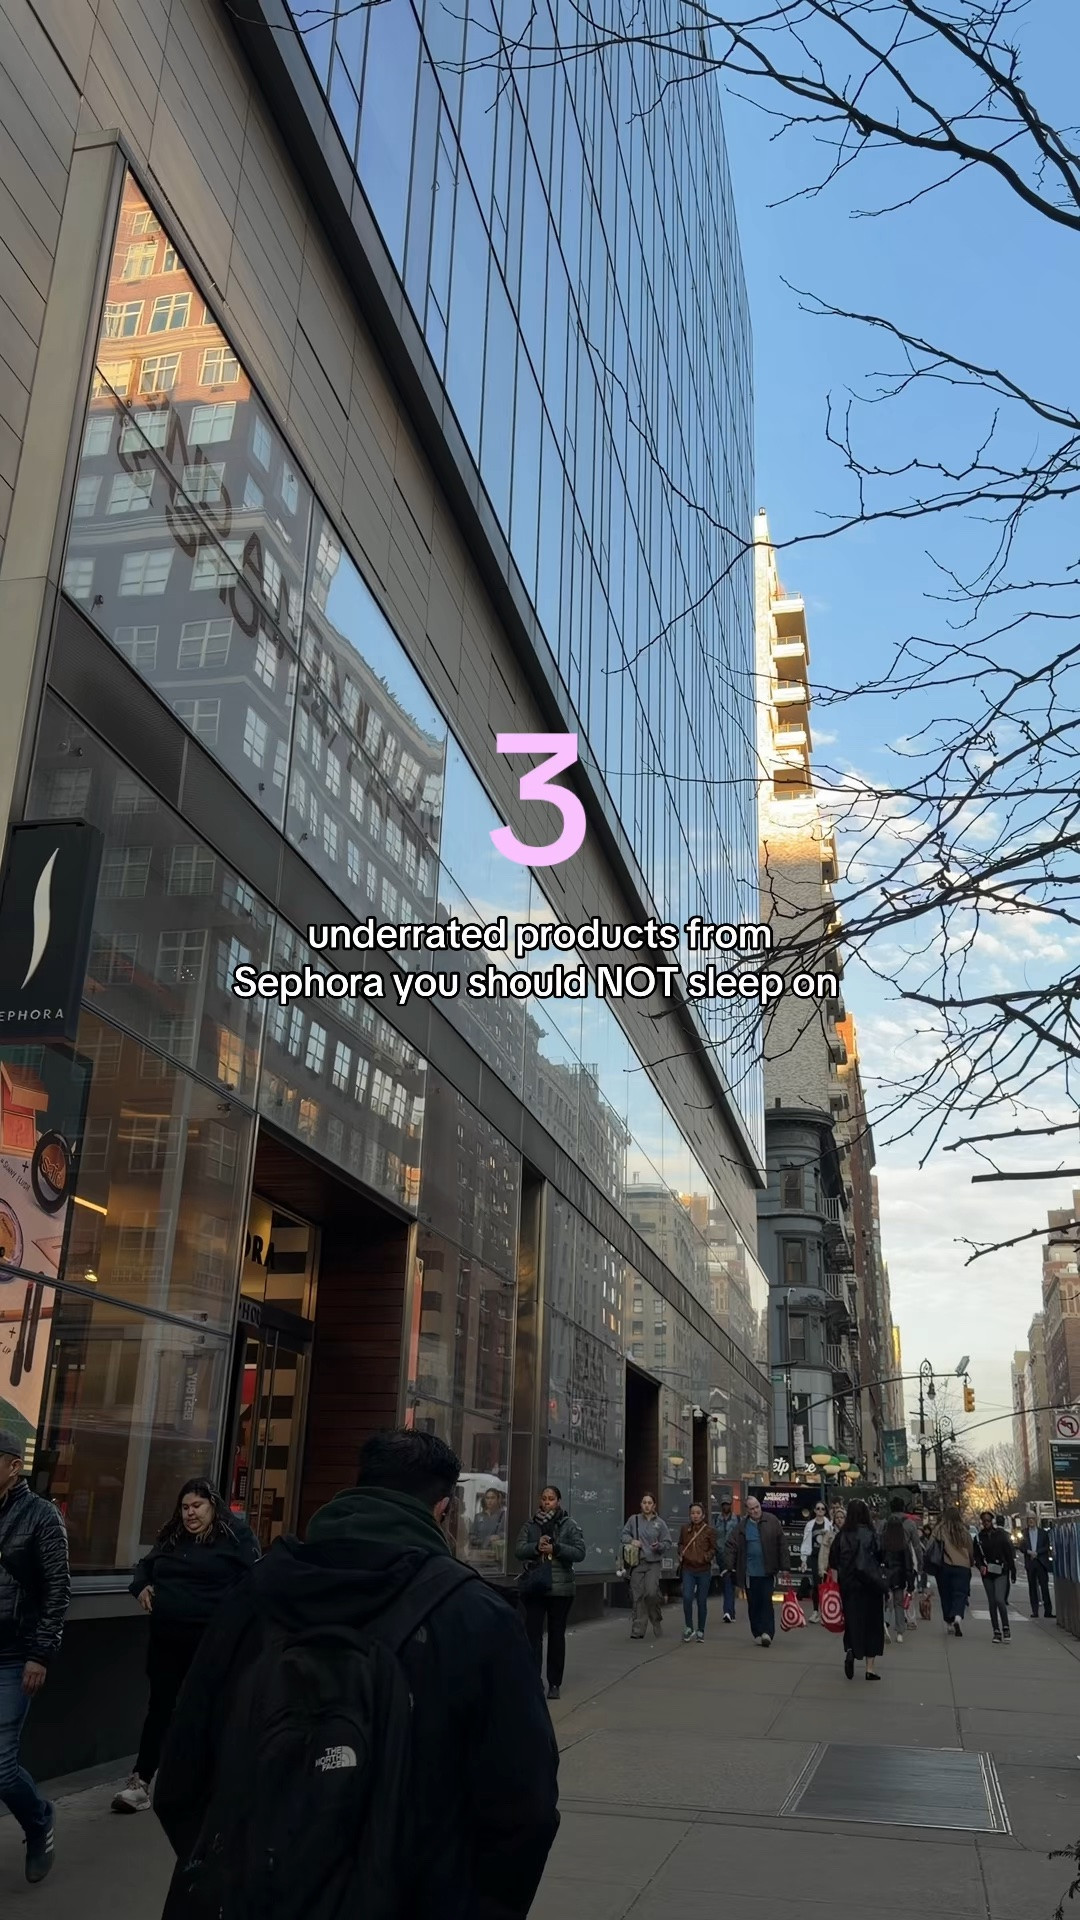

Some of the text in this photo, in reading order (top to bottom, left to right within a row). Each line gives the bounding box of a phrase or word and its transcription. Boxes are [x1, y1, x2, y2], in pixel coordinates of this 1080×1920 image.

[0, 1008, 64, 1022] EPHORA
[325, 1746, 342, 1755] THE
[315, 1754, 342, 1767] NORTH
[321, 1761, 342, 1772] FACE
